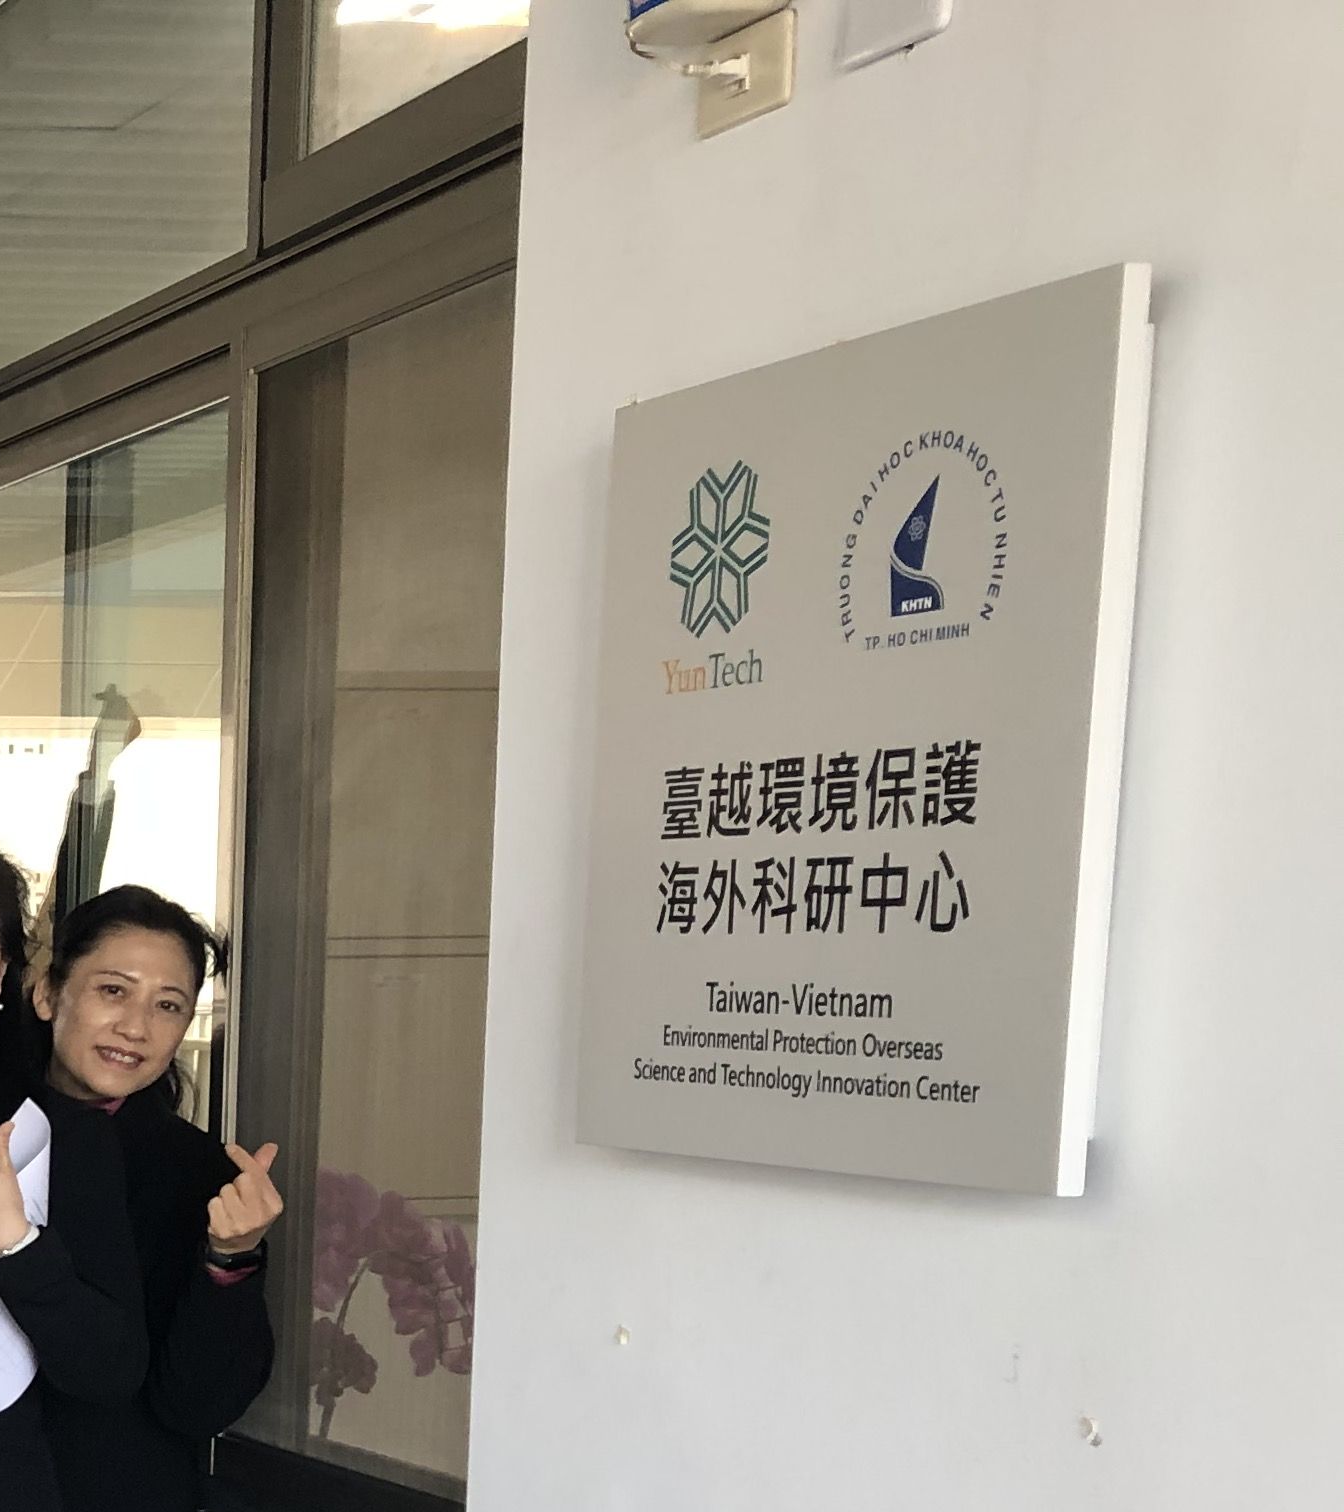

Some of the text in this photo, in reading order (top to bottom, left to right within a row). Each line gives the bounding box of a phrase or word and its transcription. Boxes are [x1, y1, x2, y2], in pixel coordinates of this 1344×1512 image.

[839, 430, 1008, 643] TRUONG DAI HOC KHOA HOC TU NHIEN
[901, 596, 933, 613] KHTN
[888, 632, 906, 648] HO
[910, 628, 932, 645] CHI
[935, 623, 970, 641] MINH
[662, 648, 764, 695] YunTech
[660, 739, 982, 841] 臺越環境保護
[656, 850, 970, 935] 海外科研中心
[705, 981, 894, 1018] Taiwan-Vietnam
[663, 1024, 944, 1062] Environmental Protection Overseas
[633, 1057, 981, 1104] Science and Technology Innovation Center
